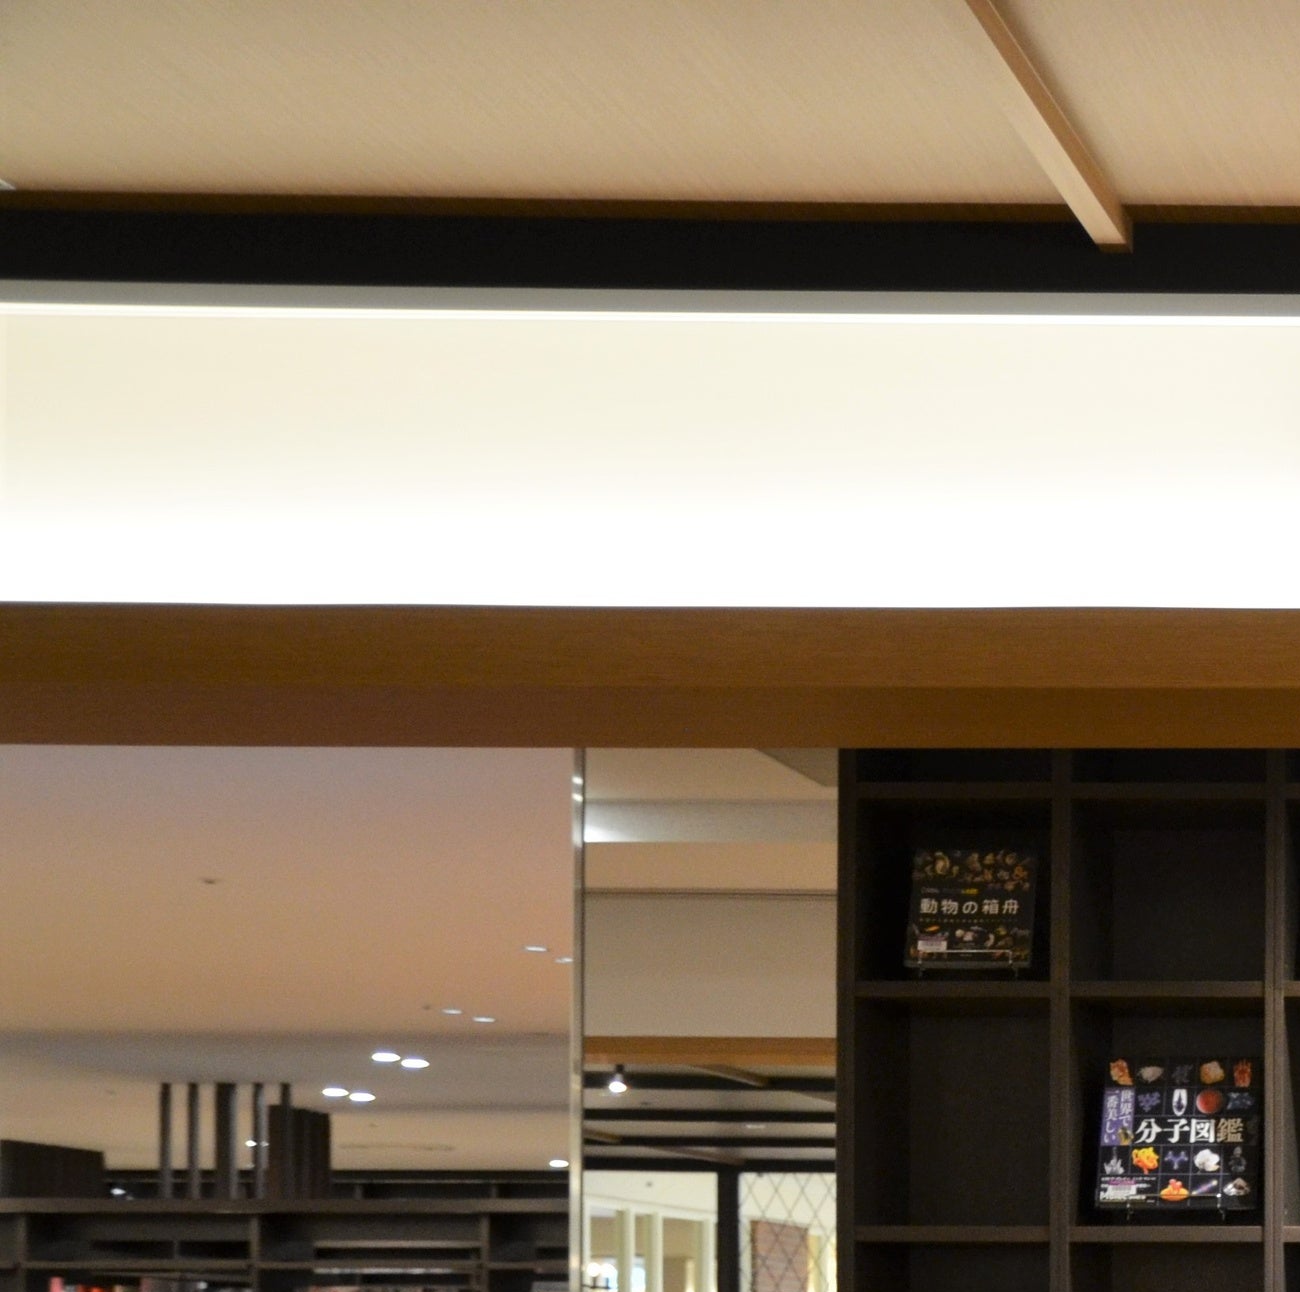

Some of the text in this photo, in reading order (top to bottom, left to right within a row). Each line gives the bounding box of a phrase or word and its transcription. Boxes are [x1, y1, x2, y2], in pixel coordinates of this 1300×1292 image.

[919, 898, 1020, 915] 動物の箱舟
[1103, 1089, 1120, 1143] 一番美しい
[1119, 1089, 1135, 1127] 世界で
[1135, 1118, 1244, 1144] 分子図鑑
